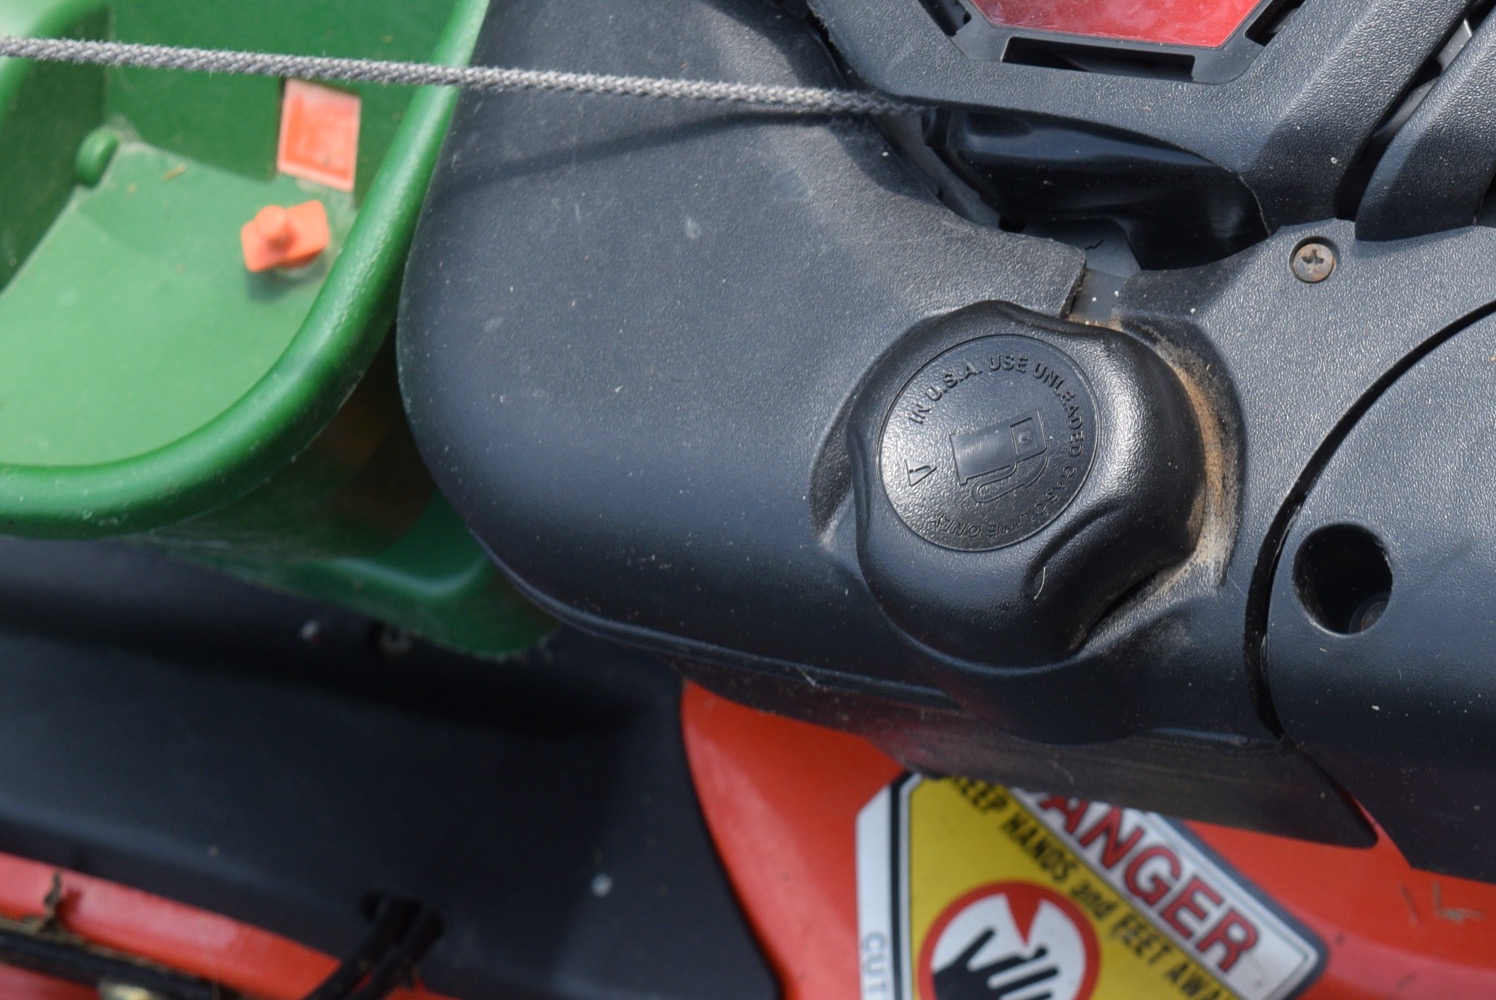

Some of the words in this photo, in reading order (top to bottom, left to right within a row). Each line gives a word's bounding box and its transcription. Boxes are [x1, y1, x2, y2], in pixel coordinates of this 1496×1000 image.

[925, 360, 983, 402] U.S.A.
[988, 353, 1029, 373] USE
[907, 402, 931, 426] IN
[1033, 361, 1085, 458] UNLEADED
[929, 511, 983, 538] ONLY
[987, 464, 1076, 537] GASOLINE
[1001, 812, 1078, 882] HANDS
[1111, 912, 1172, 966] FEET
[1038, 794, 1259, 973] ANGER
